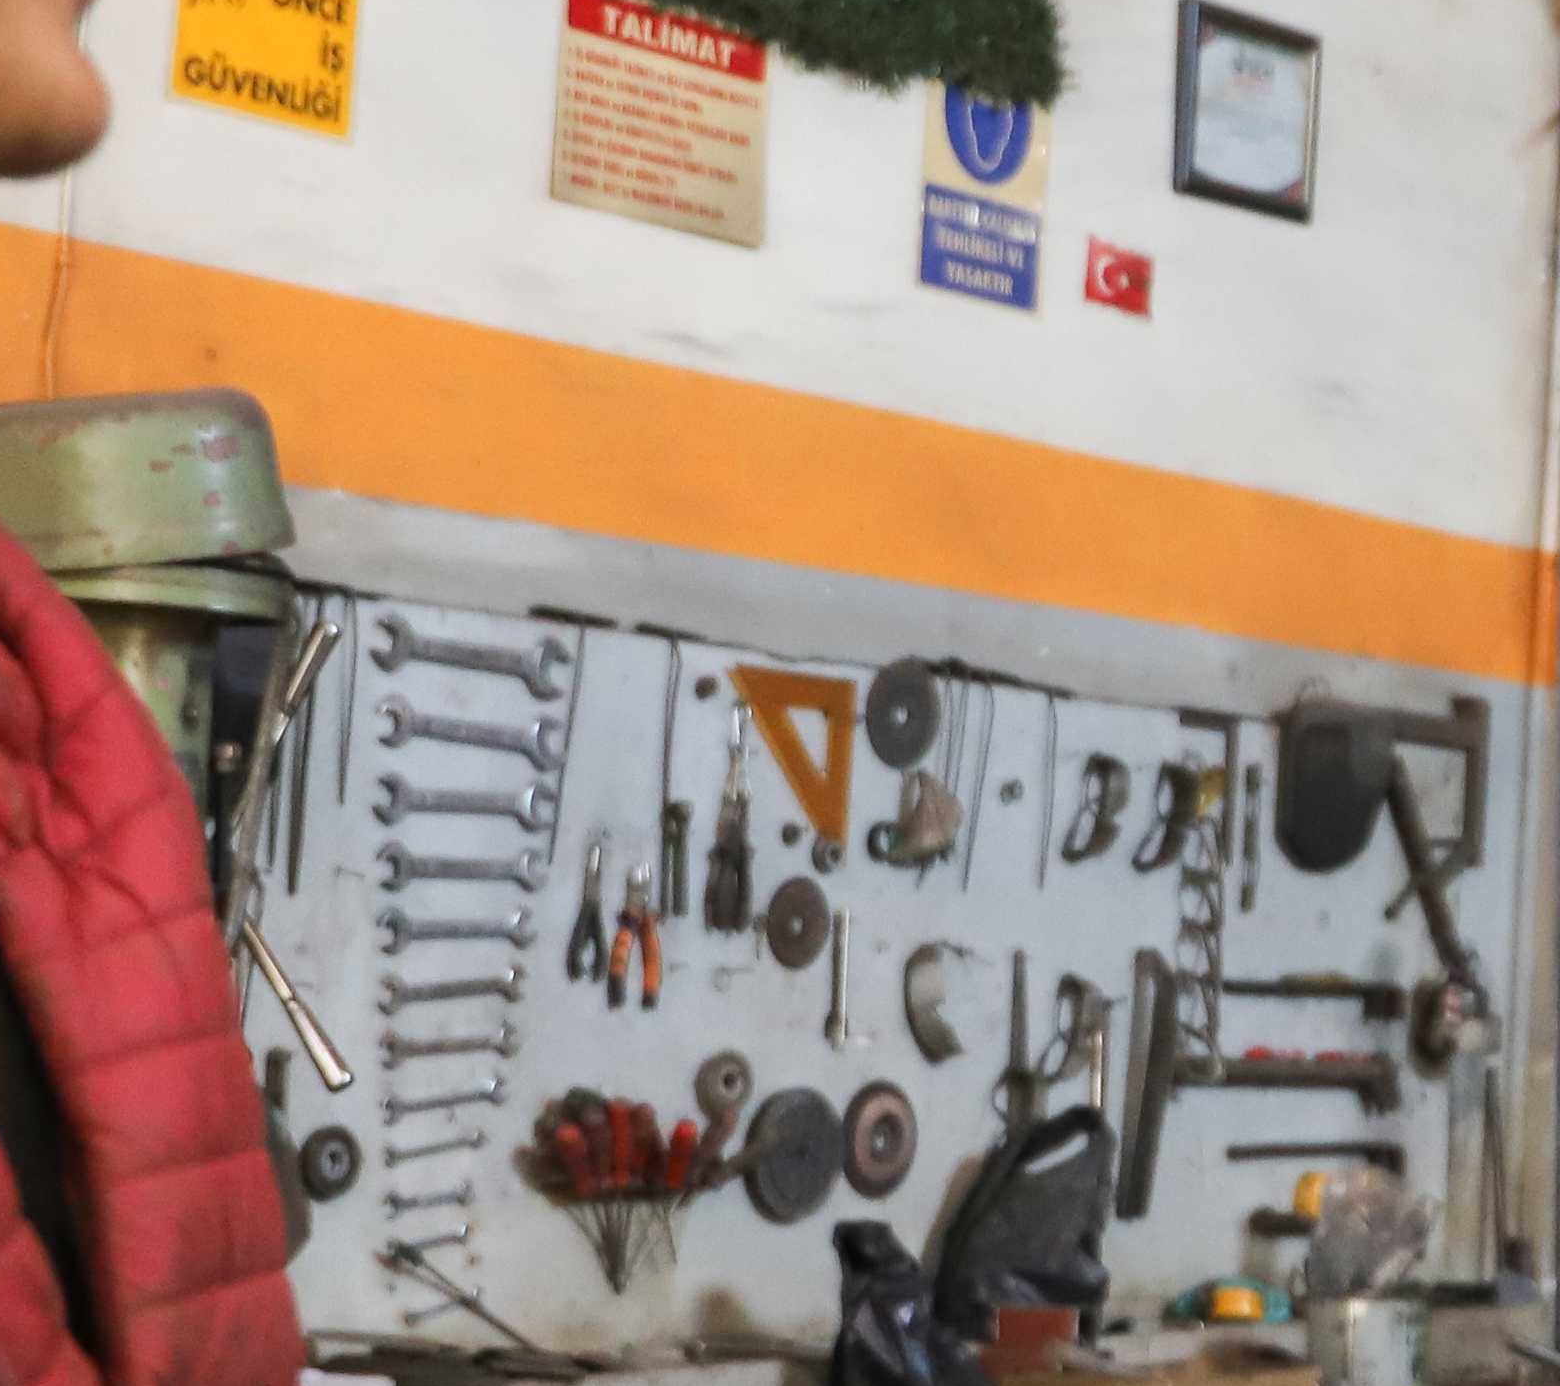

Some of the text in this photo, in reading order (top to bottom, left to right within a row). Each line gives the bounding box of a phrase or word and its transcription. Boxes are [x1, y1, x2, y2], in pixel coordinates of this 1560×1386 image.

[320, 29, 345, 76] İŞ
[603, 5, 737, 70] TALİMAT
[184, 50, 343, 124] GÜVENLİĞİ
